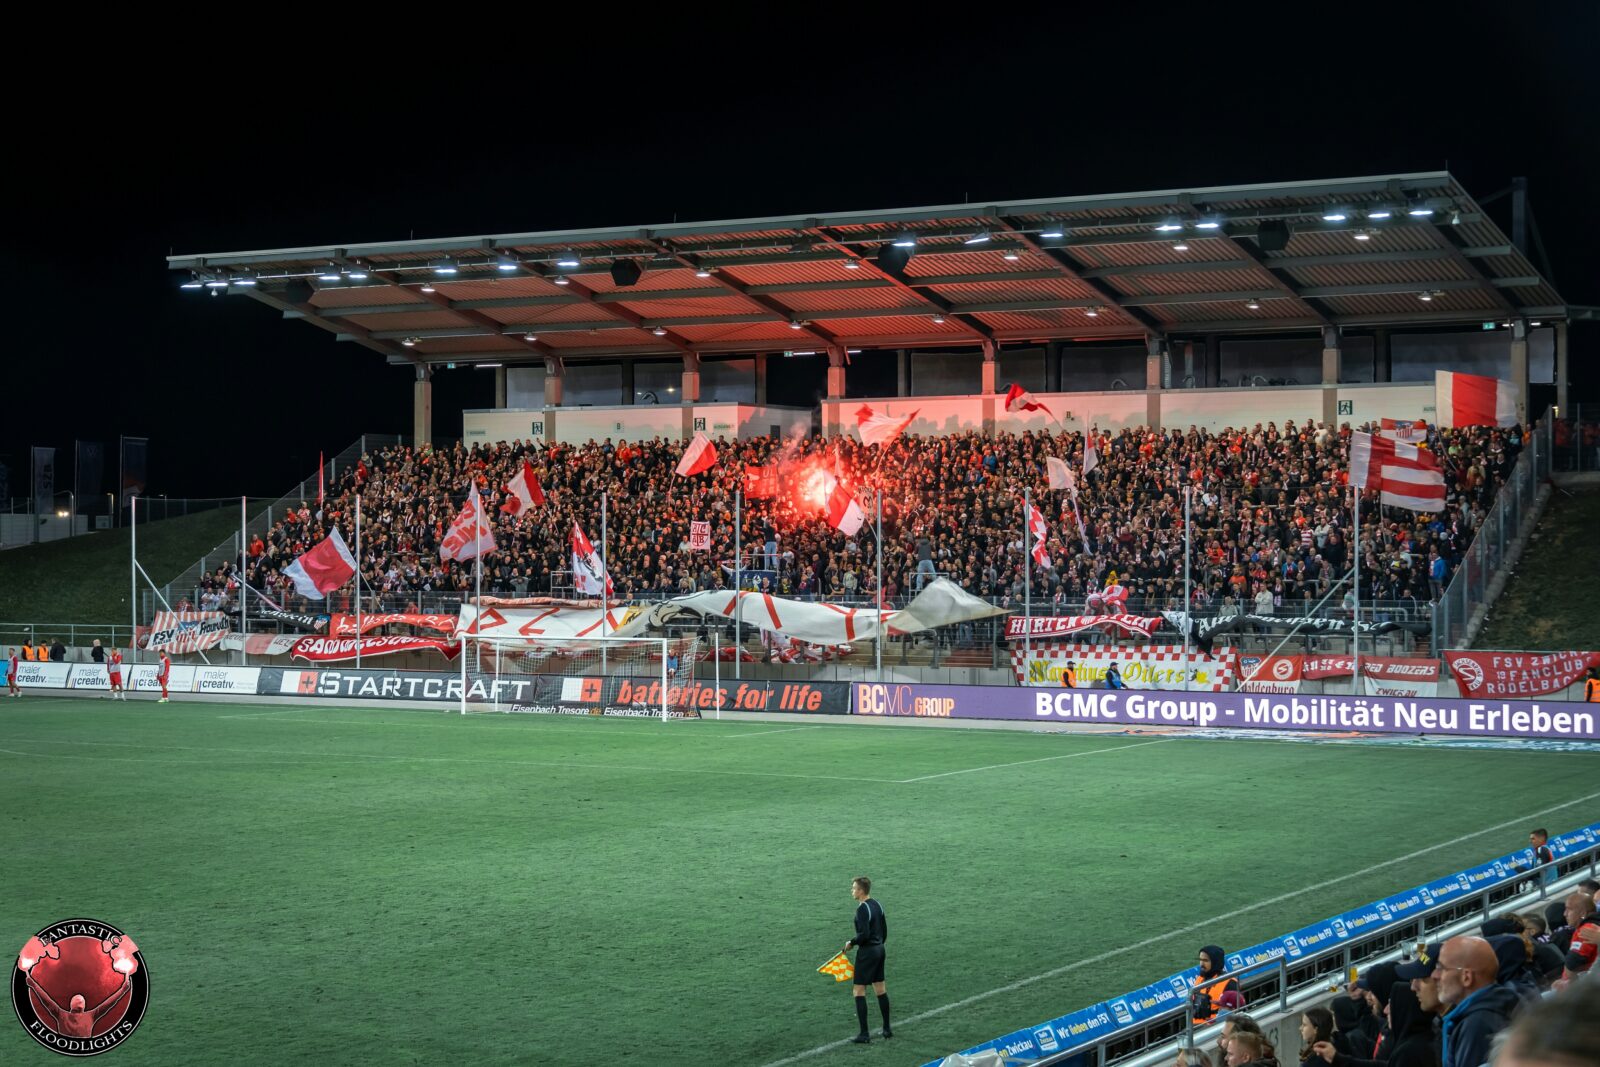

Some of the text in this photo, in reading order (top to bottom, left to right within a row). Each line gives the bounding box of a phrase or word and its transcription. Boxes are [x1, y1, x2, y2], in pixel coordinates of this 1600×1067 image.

[153, 629, 175, 642] FSV
[1386, 663, 1436, 676] BOOZERS
[1492, 656, 1524, 669] FSV
[1508, 659, 1583, 681] FANCLUB
[317, 671, 531, 700] STARTCRAFT
[735, 683, 774, 709] for
[779, 684, 823, 711] life
[858, 683, 955, 717] BCMC GROUP
[603, 707, 649, 717] Eisenbach
[1035, 692, 1118, 719] BCMC
[1125, 694, 1217, 727] Group
[1243, 697, 1385, 727] Mobilität
[1394, 703, 1458, 730] Neu
[1469, 704, 1594, 734] Erleben
[1057, 1027, 1070, 1039] Wir
[1068, 1022, 1090, 1036] lieben
[1087, 1017, 1100, 1029] den
[1005, 1039, 1033, 1056] Zwickau
